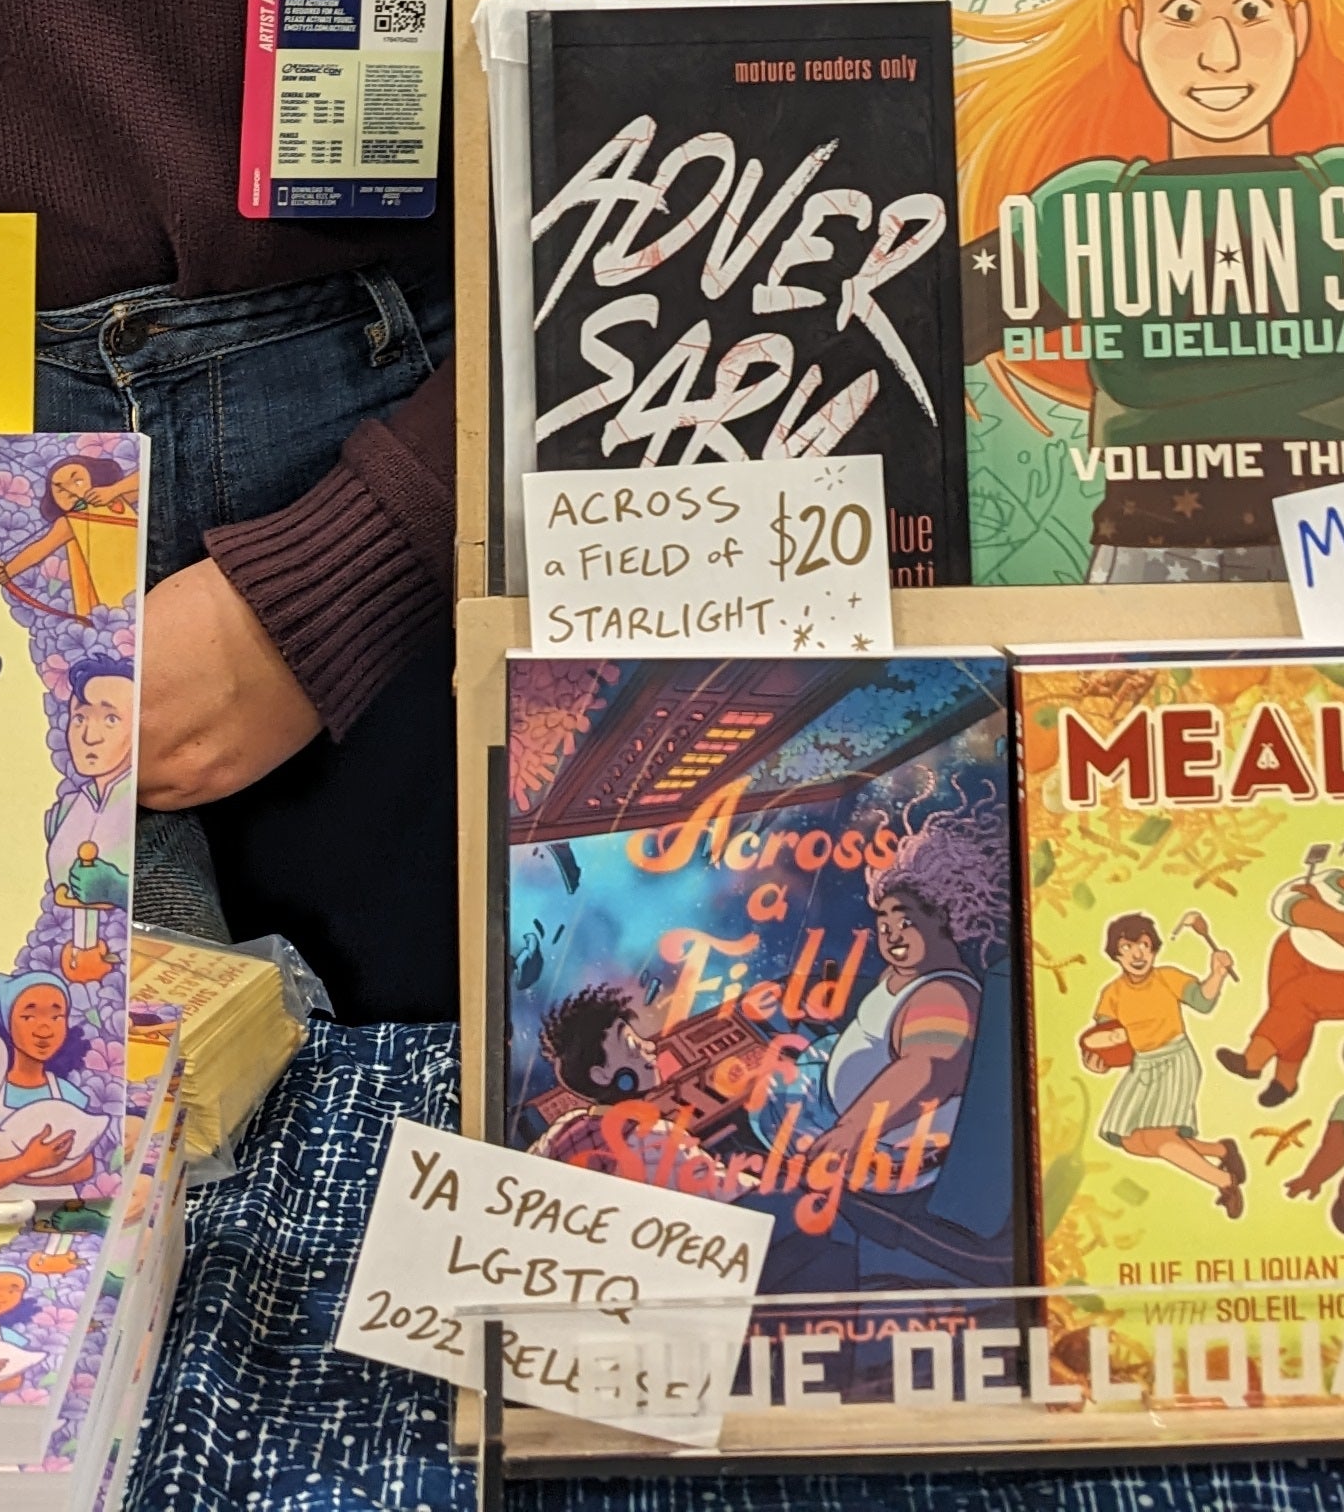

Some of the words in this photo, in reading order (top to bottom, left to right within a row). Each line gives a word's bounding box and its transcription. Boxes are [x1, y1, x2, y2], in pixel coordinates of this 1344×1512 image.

[259, 8, 274, 53] ARTIST
[734, 57, 797, 83] mature
[804, 56, 872, 82] readers
[880, 54, 919, 83] only
[530, 114, 947, 428] ADVER
[998, 194, 1040, 319] O
[1062, 188, 1301, 319] HUMAN
[1004, 324, 1124, 361] BLUE
[1069, 442, 1264, 482] VOLUME
[544, 556, 565, 576] a
[580, 543, 690, 580] FIELD
[707, 542, 744, 568] of
[547, 485, 742, 528] ACROSS
[768, 491, 873, 582] $20
[890, 507, 934, 555] lue
[623, 776, 903, 875] Across
[747, 880, 788, 922] a
[659, 926, 867, 1037] Field
[714, 1033, 814, 1112] of
[570, 1097, 950, 1237] Starlight
[410, 1149, 460, 1213] YA
[485, 1175, 620, 1246] SPACE
[630, 1216, 750, 1284] OPERA
[446, 1235, 640, 1324] LGBTQ
[1119, 1261, 1182, 1285] BLUE
[358, 1289, 466, 1358] 2022
[1144, 1300, 1207, 1325] WITH
[1216, 1295, 1306, 1322] SOLEIL
